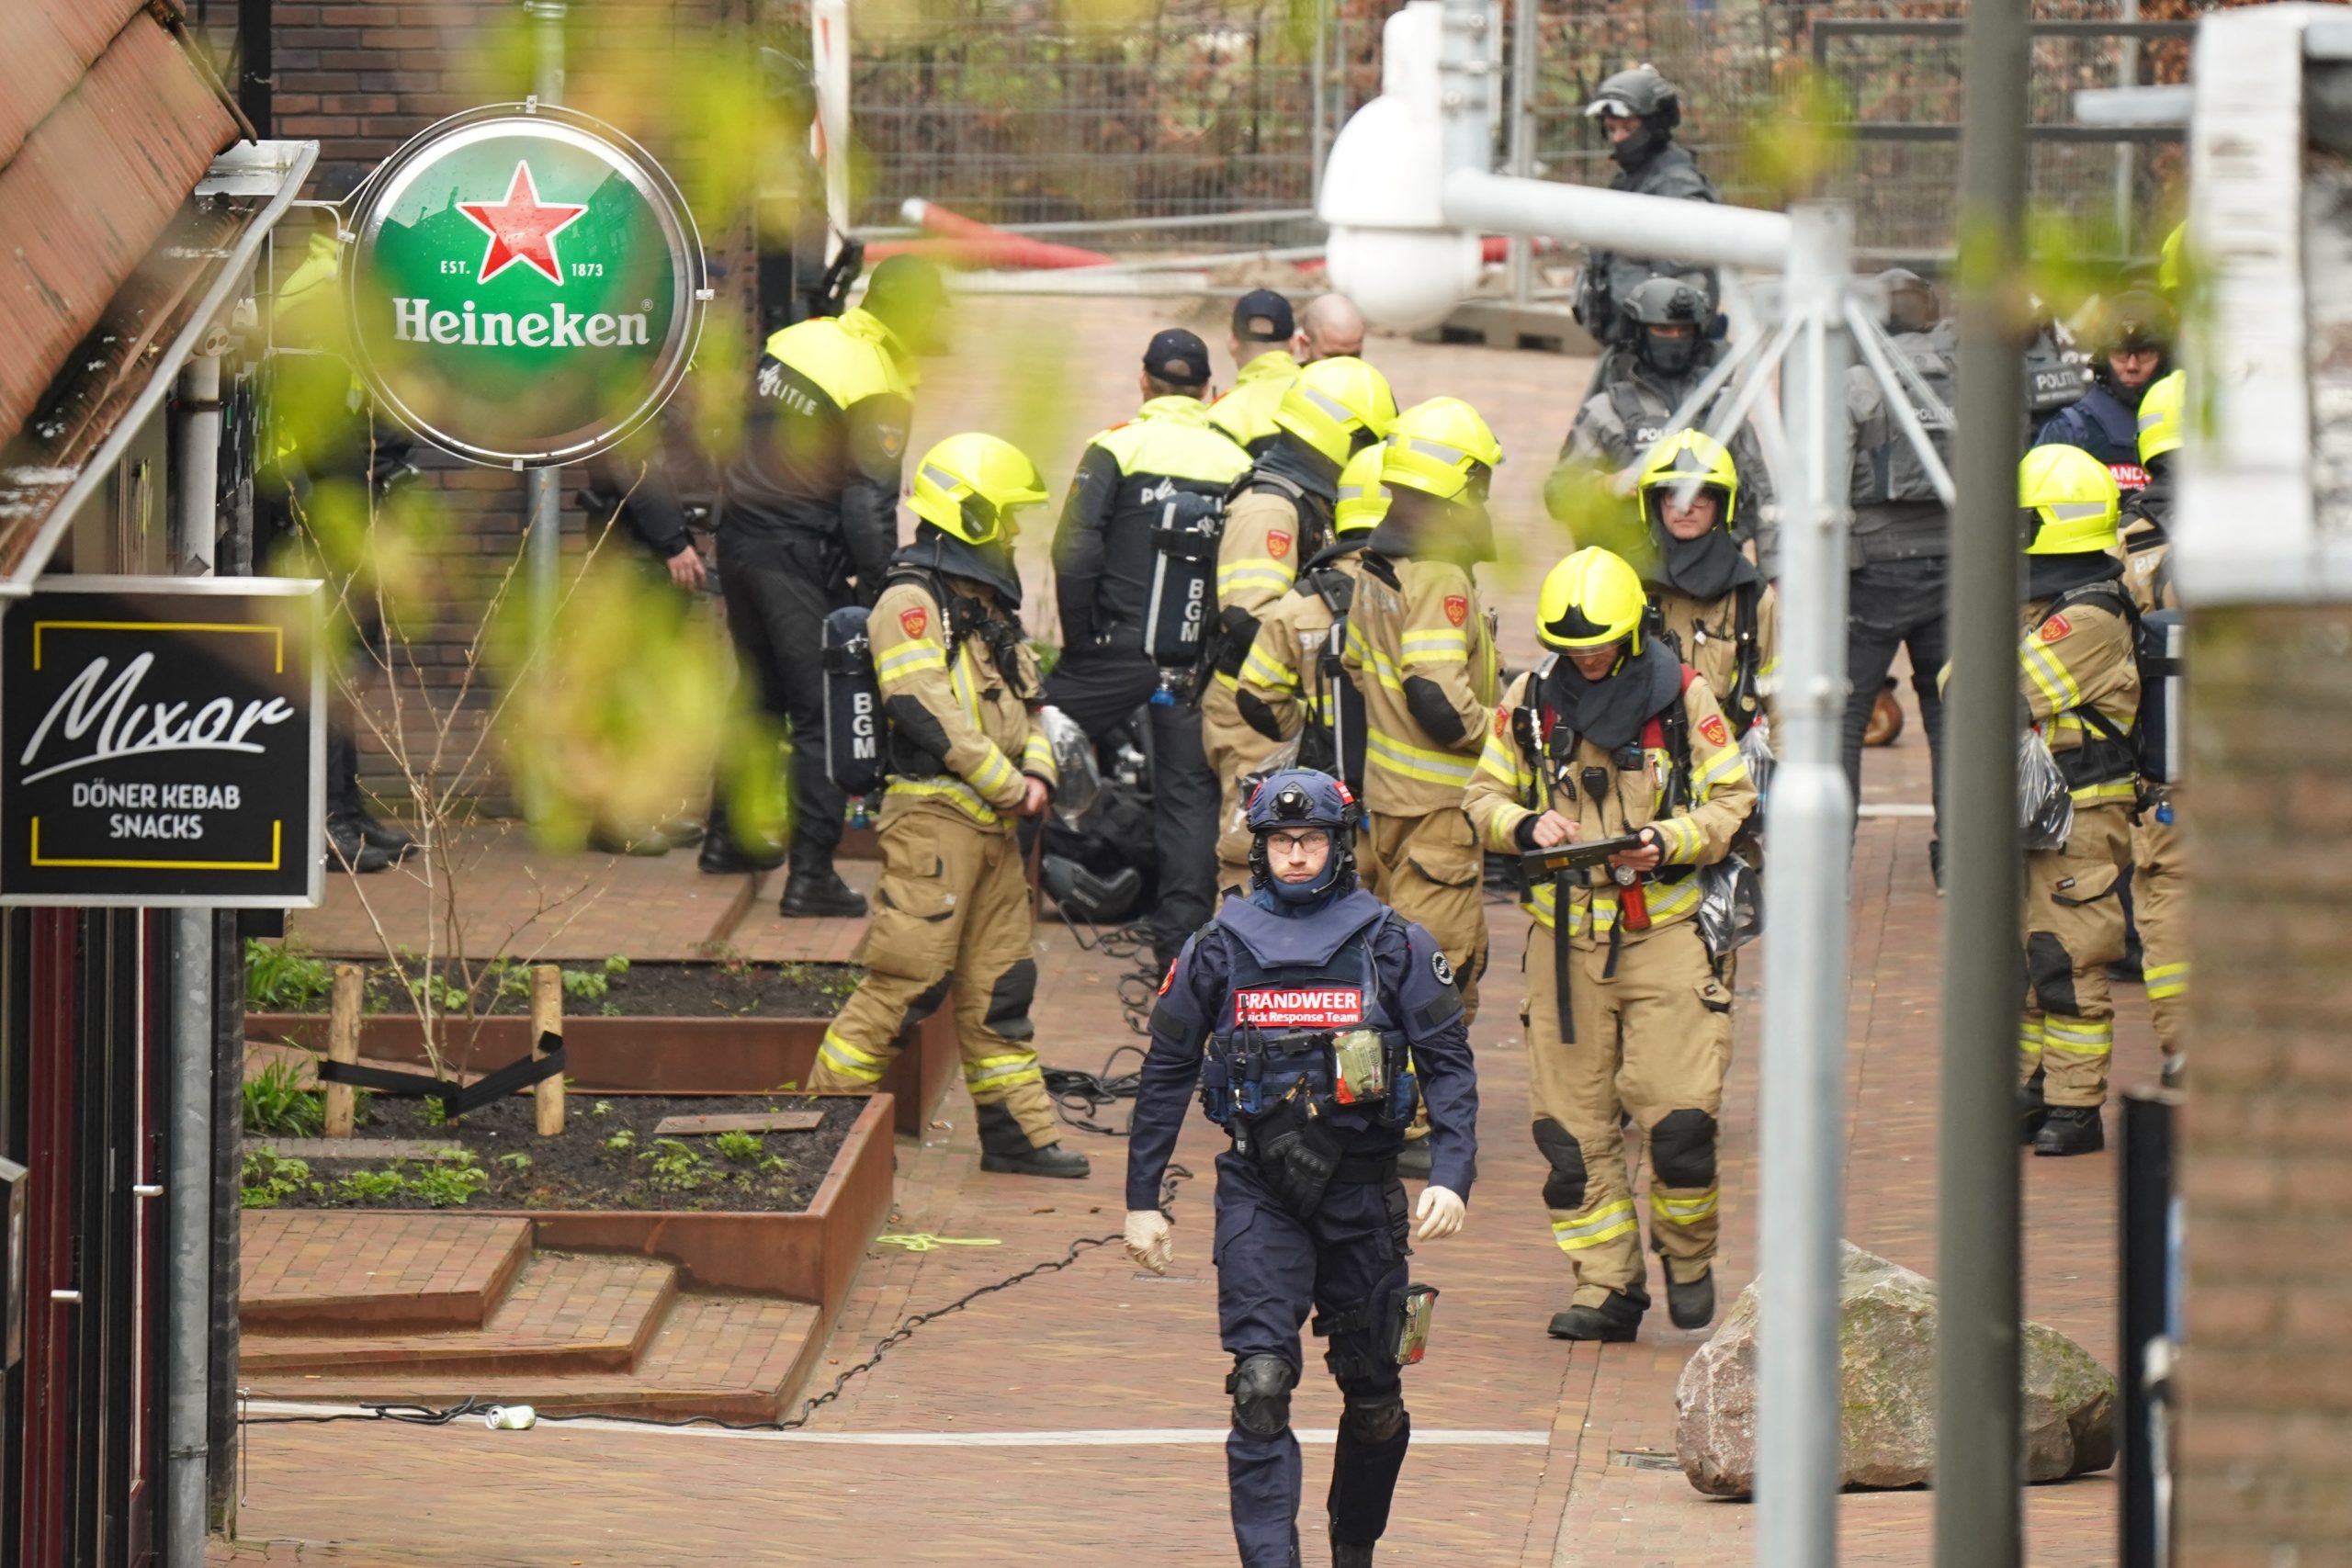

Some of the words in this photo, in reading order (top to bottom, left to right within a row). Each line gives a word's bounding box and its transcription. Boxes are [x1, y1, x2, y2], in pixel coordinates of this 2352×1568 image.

[440, 260, 470, 275] EST.
[571, 263, 603, 276] 1873
[392, 297, 650, 348] Heineken
[1180, 578, 1205, 642] BGM
[852, 691, 876, 760] BGM
[72, 778, 157, 808] DÖNER
[162, 784, 241, 810] KEBAB
[109, 813, 204, 840] SNACKS
[1269, 1011, 1324, 1024] Response
[1325, 1011, 1359, 1022] Team
